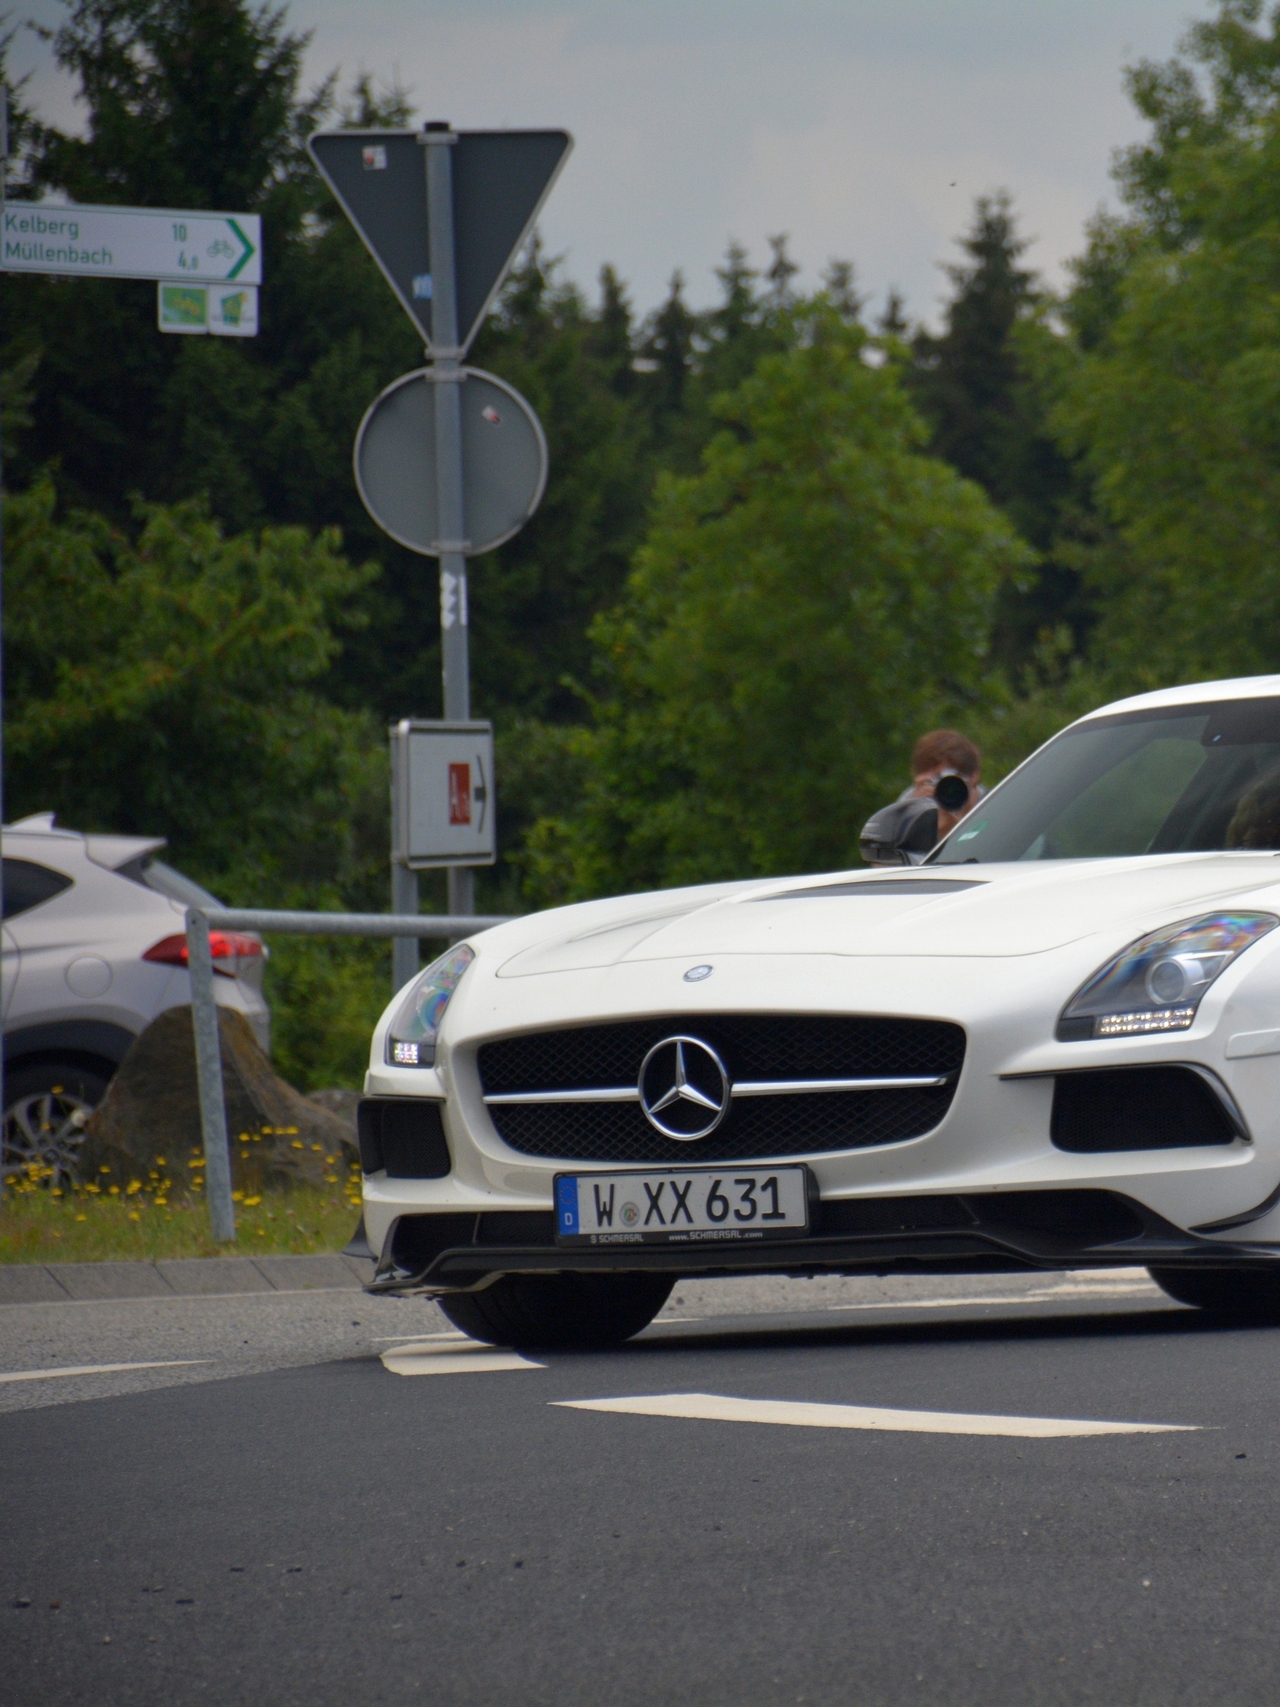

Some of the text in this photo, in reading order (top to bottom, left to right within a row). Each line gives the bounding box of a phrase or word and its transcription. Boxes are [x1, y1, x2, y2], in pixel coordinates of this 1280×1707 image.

[5, 214, 187, 242] Kelberg 10
[5, 242, 113, 265] Müllenbach
[594, 1176, 786, 1228] W XX 631
[564, 1213, 574, 1226] D
